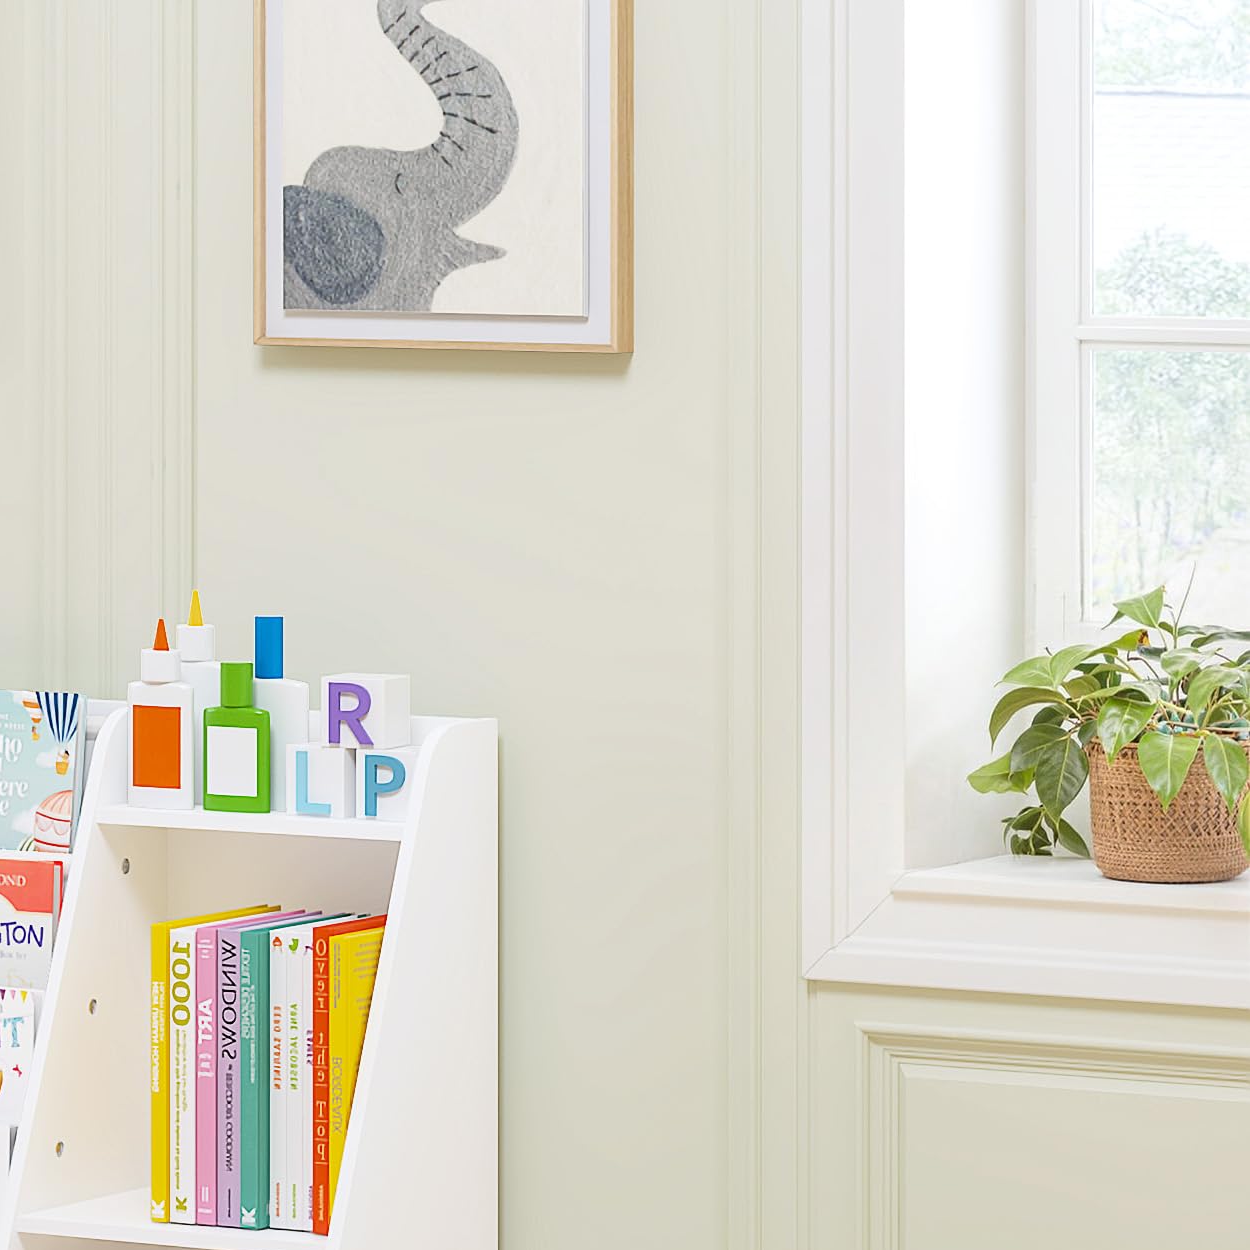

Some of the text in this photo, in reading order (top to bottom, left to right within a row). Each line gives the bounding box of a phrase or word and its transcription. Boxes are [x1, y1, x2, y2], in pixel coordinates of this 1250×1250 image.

[328, 682, 375, 746] R
[295, 750, 406, 817] L P
